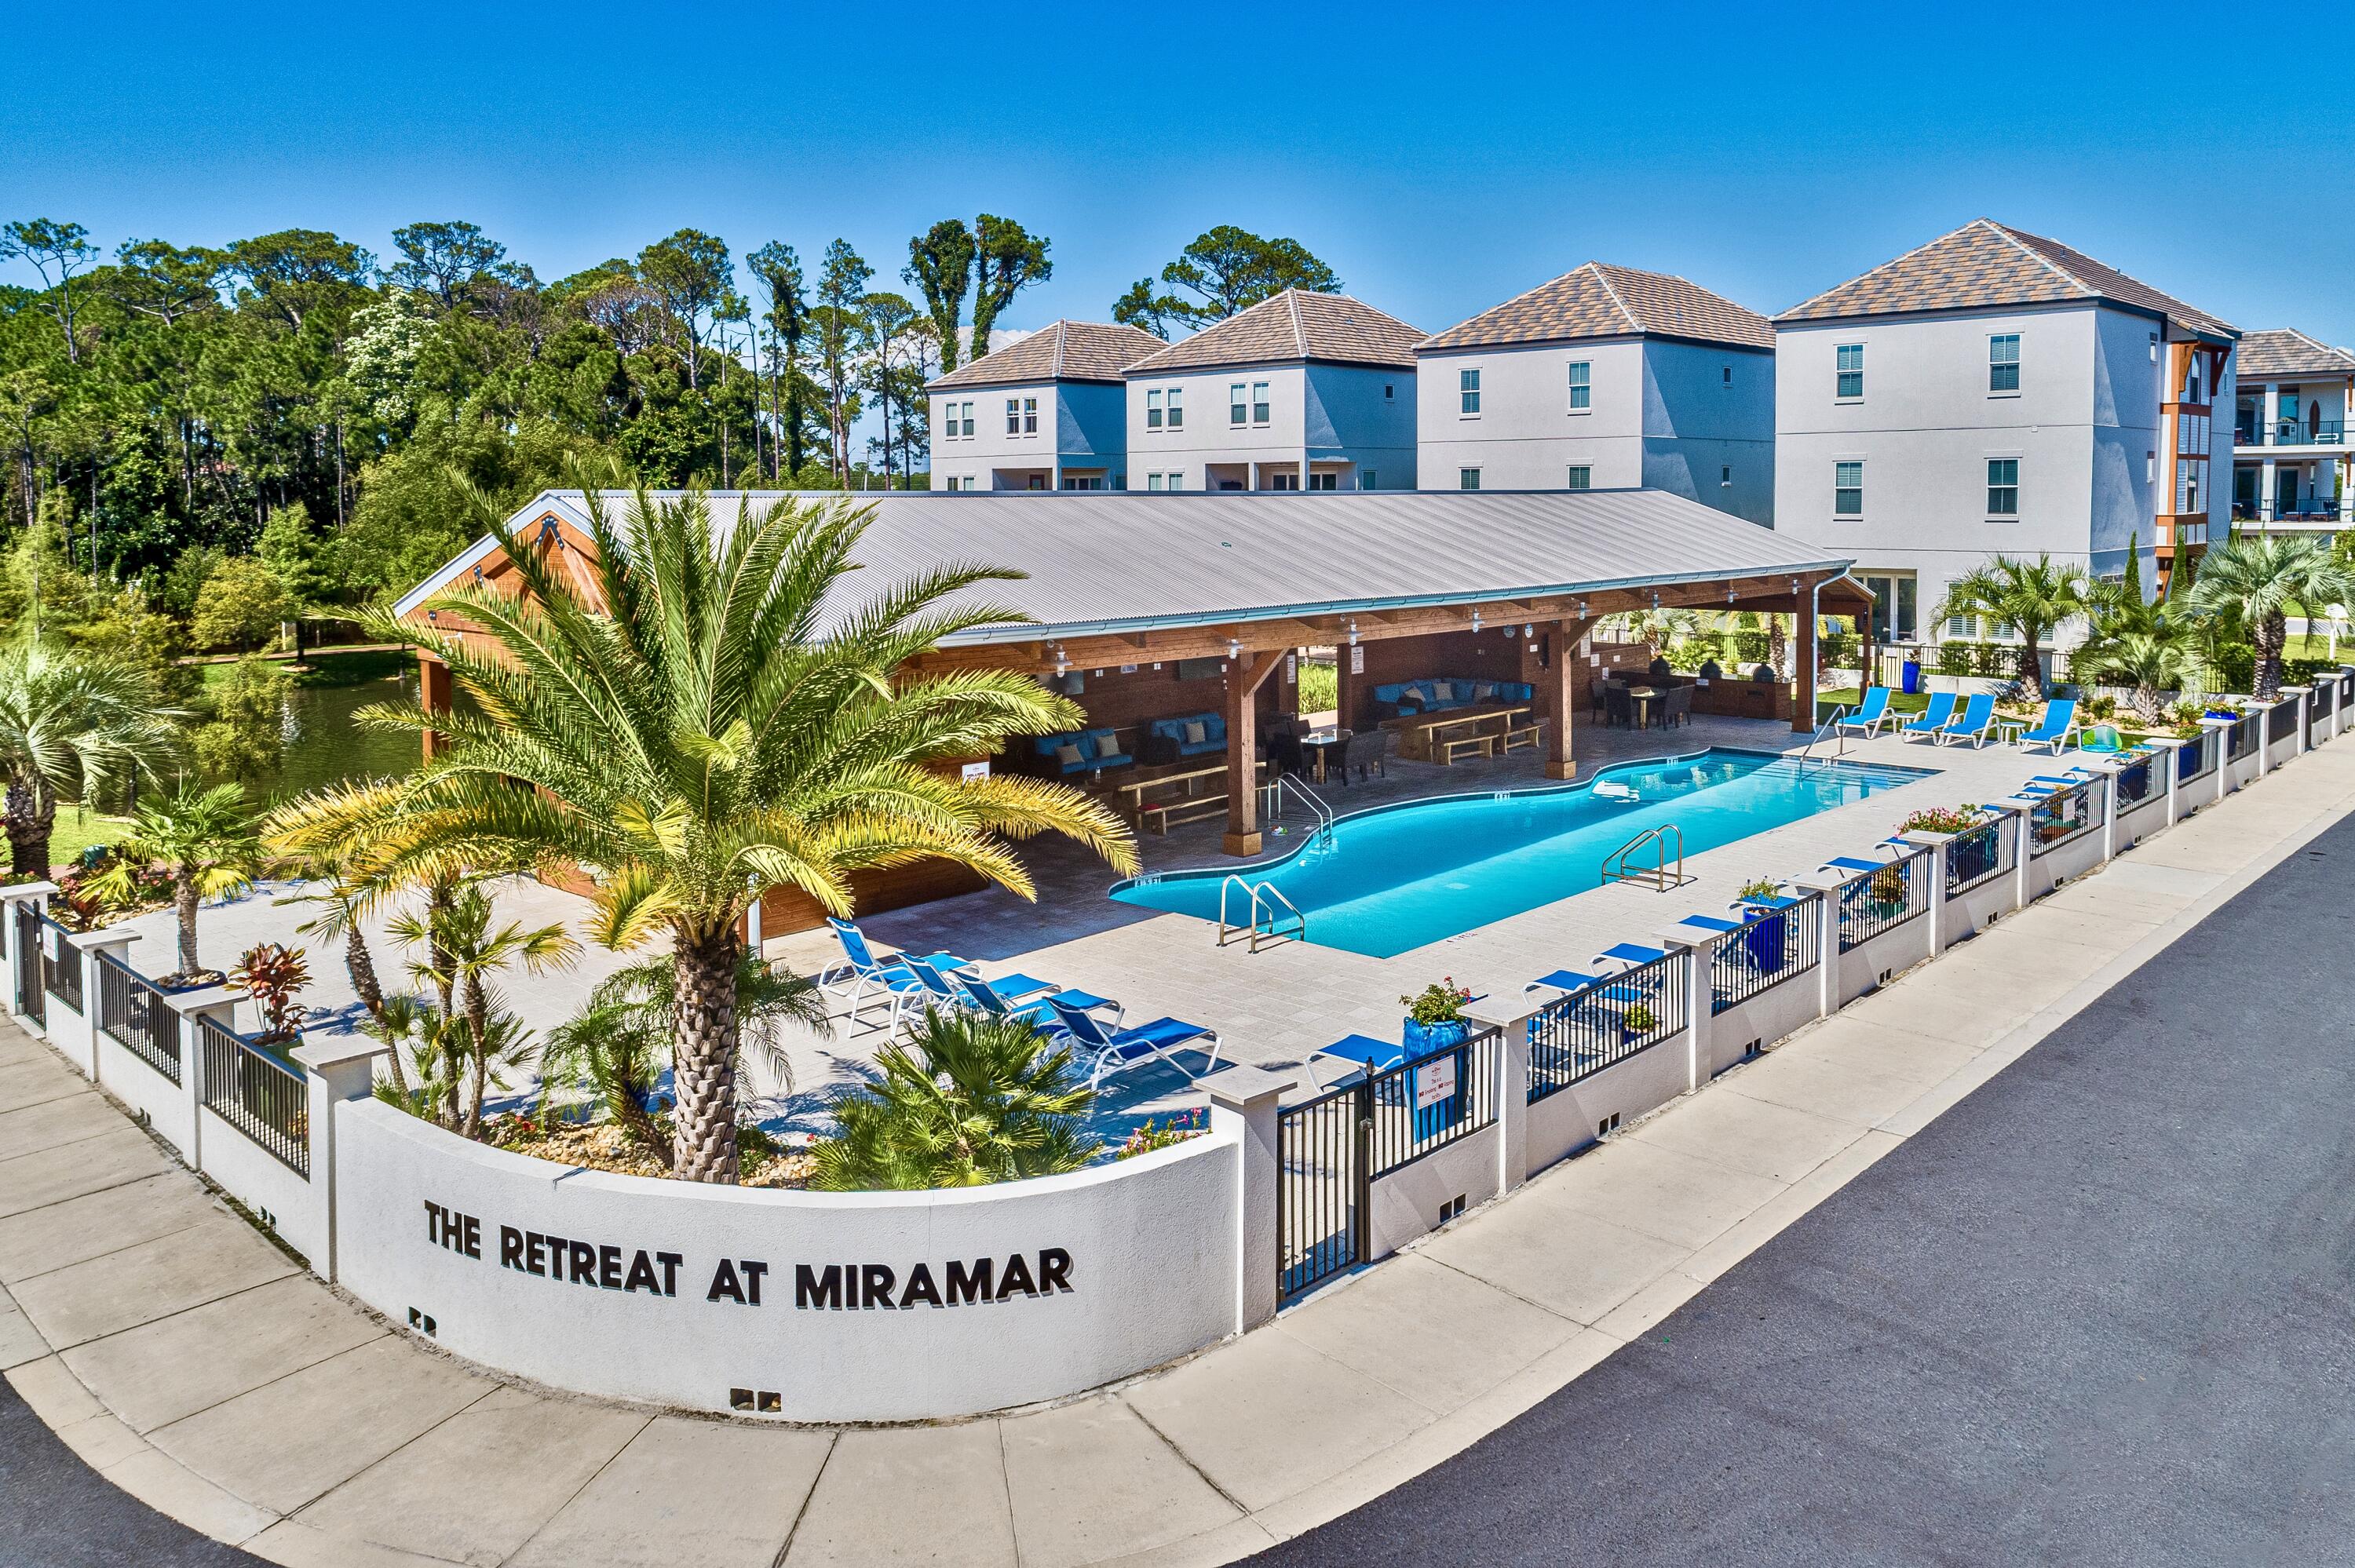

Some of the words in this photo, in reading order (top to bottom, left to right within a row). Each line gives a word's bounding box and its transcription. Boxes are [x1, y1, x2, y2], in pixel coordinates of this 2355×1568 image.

[424, 1199, 481, 1260] THE
[500, 1224, 683, 1297] RETREAT
[706, 1258, 768, 1307] AT
[795, 1247, 1074, 1310] MIRAMAR
